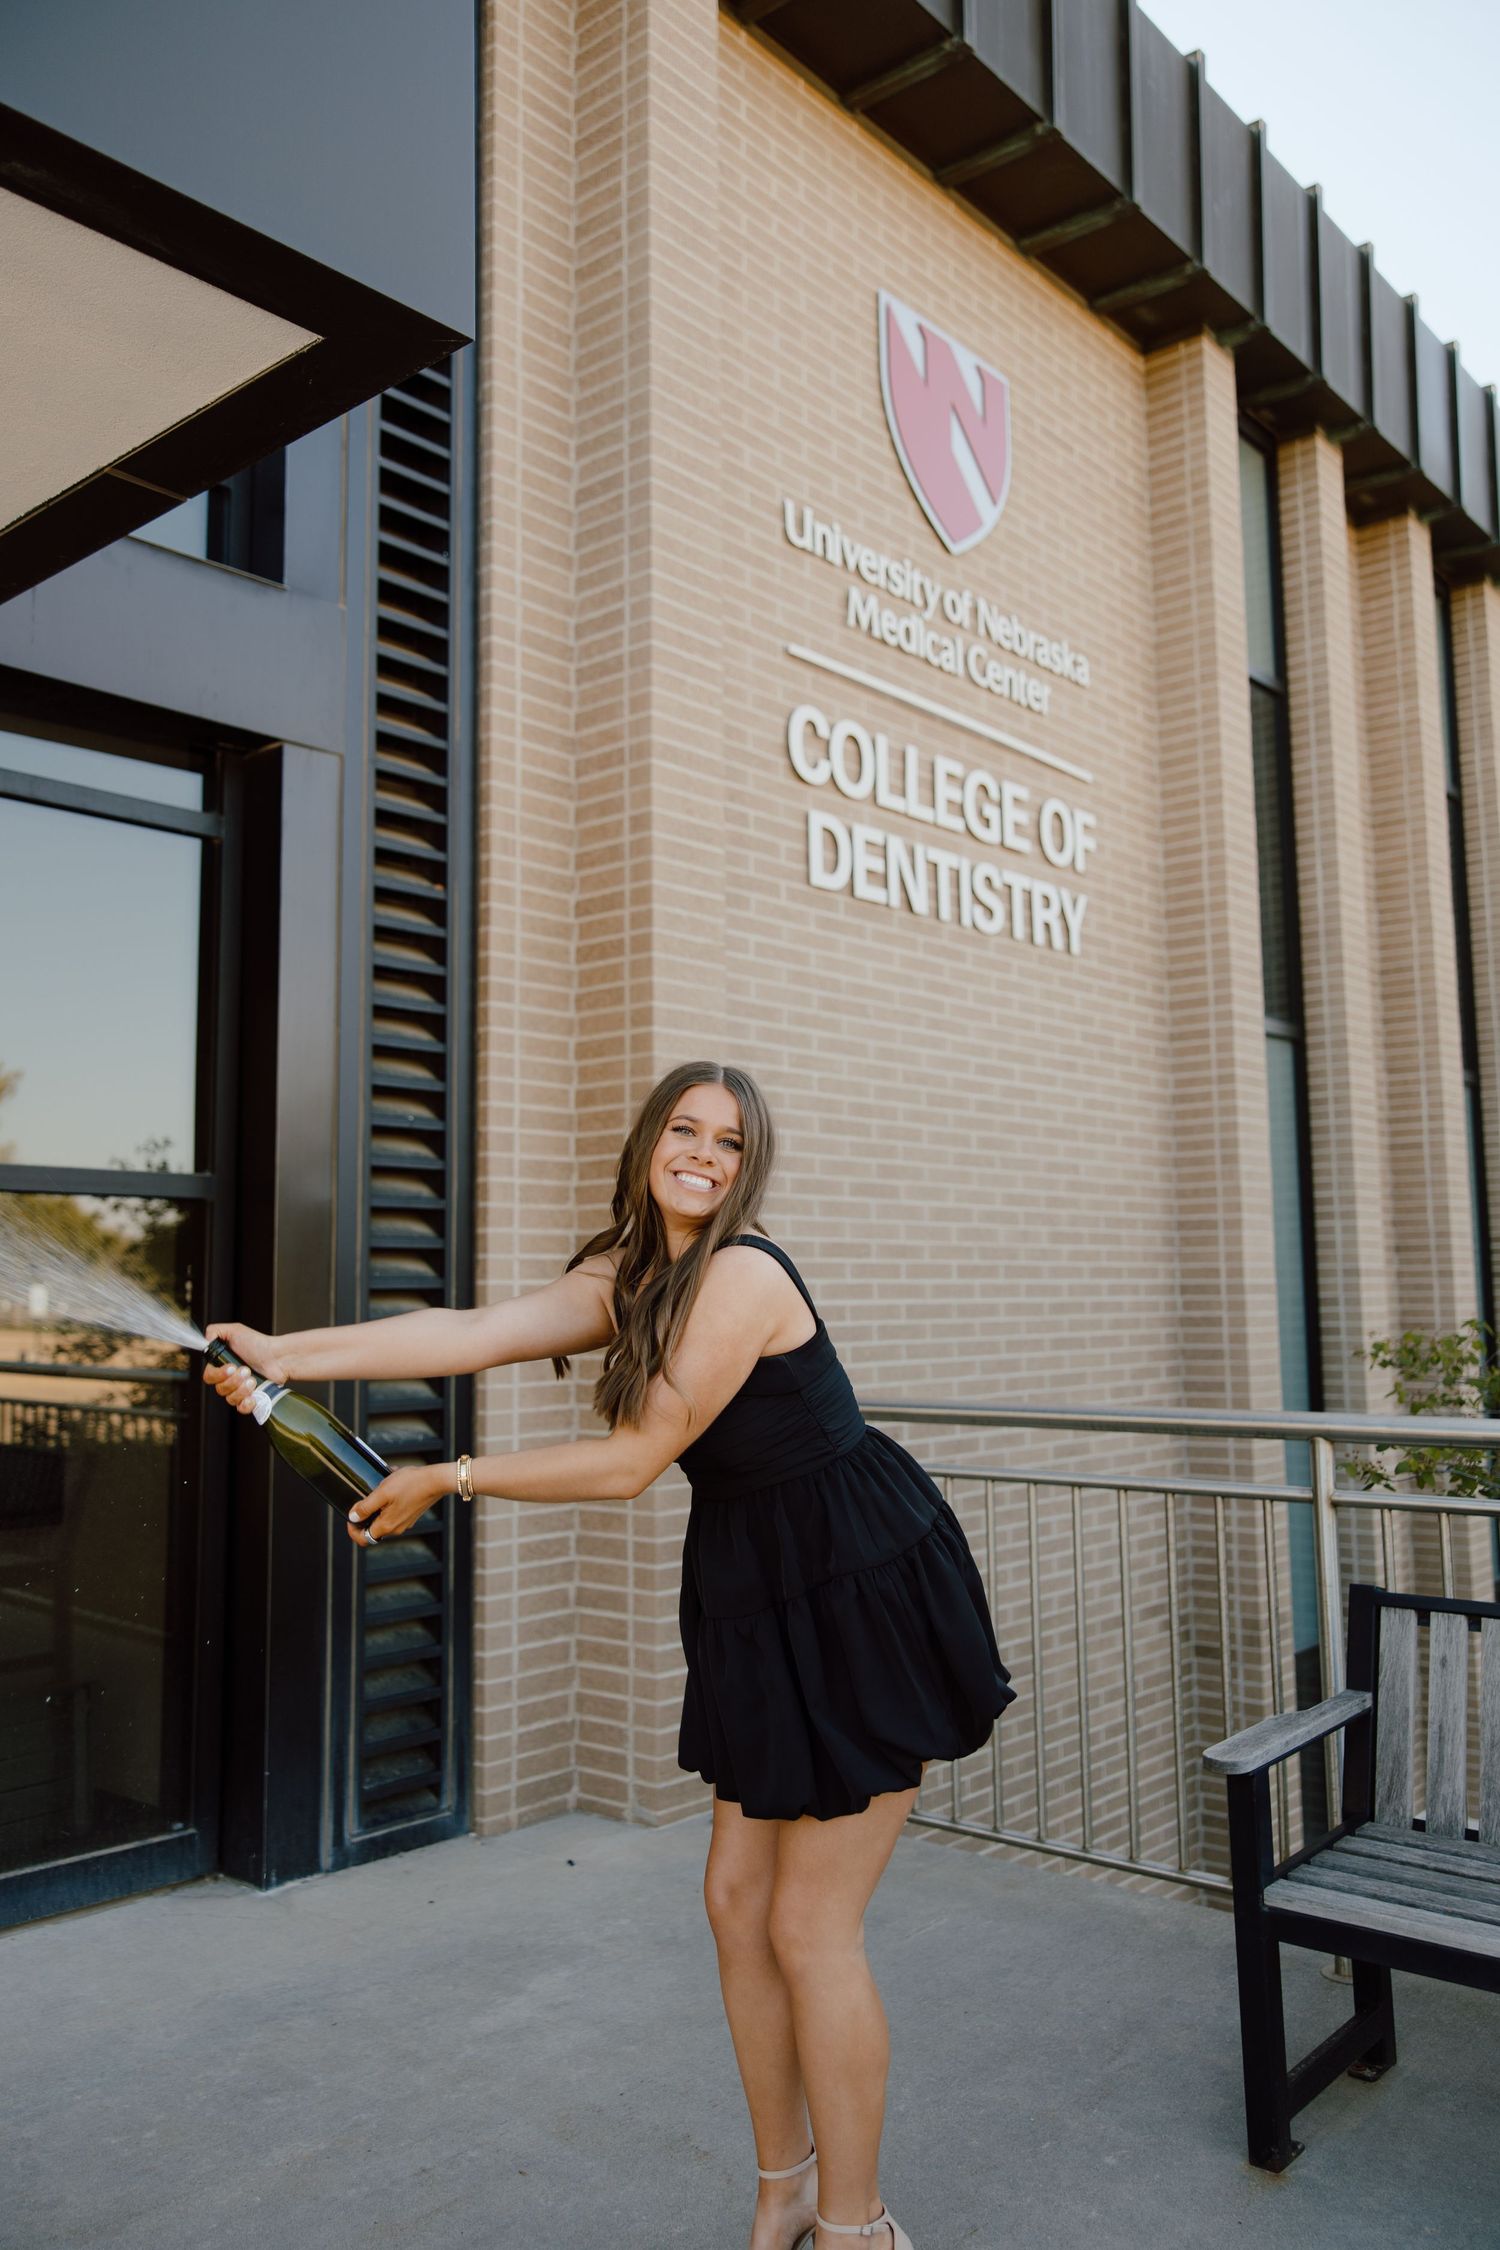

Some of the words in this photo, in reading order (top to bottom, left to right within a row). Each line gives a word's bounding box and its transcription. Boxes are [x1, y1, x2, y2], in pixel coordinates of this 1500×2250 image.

[783, 497, 941, 621] University
[943, 587, 972, 629] of
[976, 596, 1090, 687] Nebraska
[847, 585, 964, 676] Medical
[966, 644, 1051, 714] Center
[787, 703, 1033, 854] COLLEGE
[1039, 798, 1097, 874] OF
[806, 808, 1088, 956] DENTISTRY
